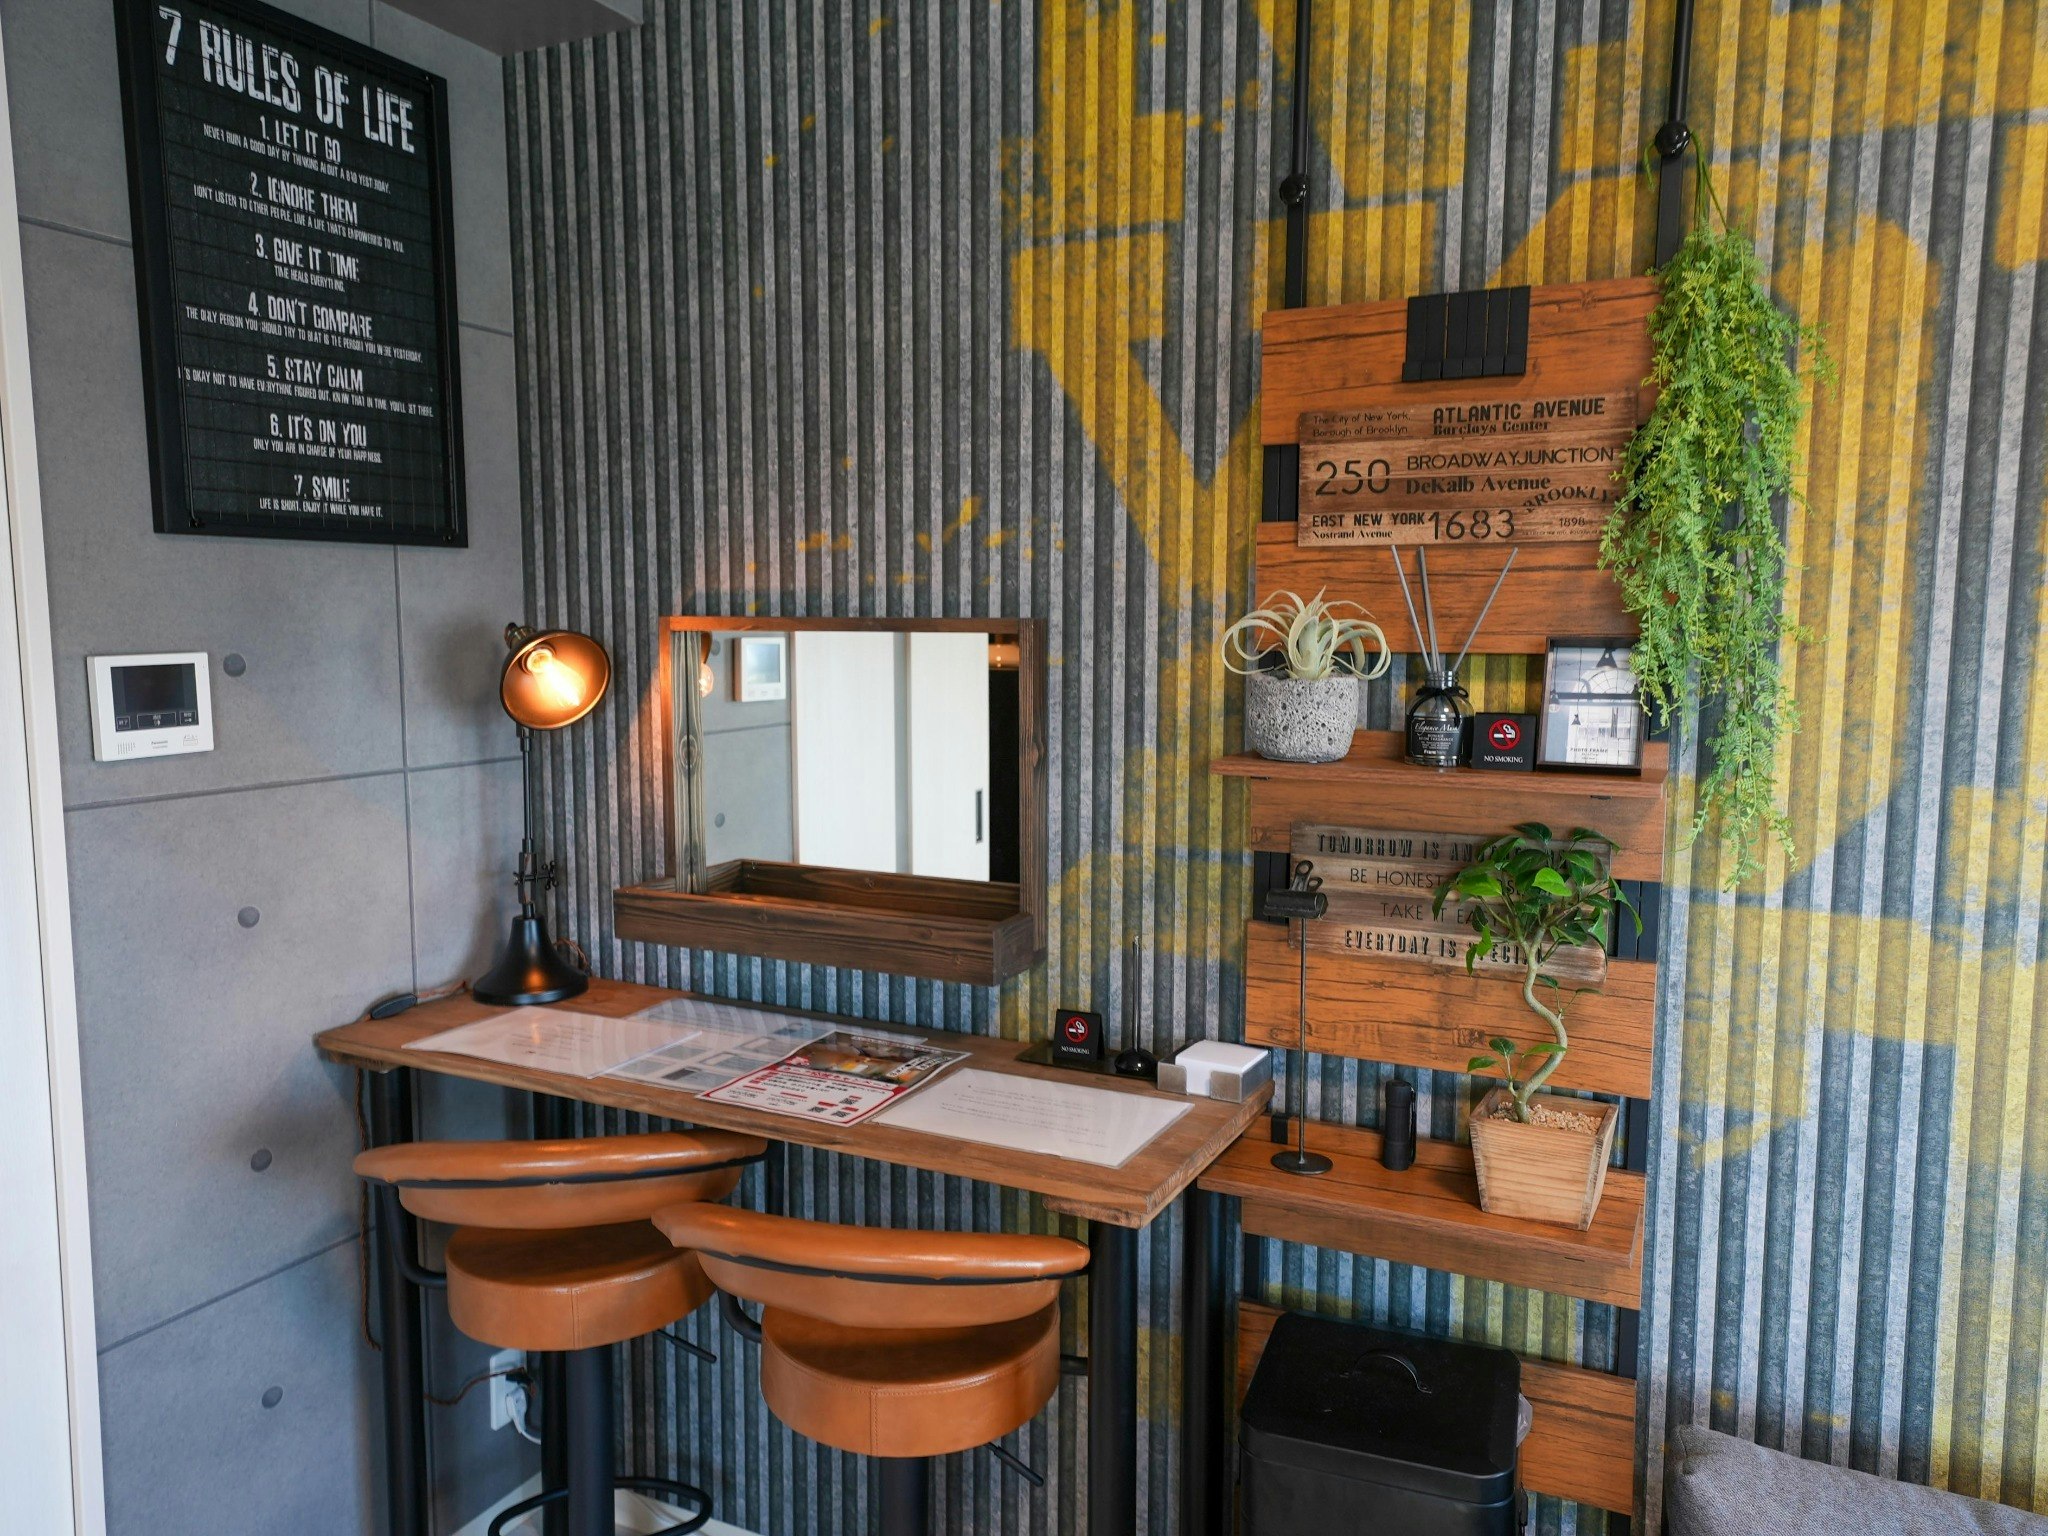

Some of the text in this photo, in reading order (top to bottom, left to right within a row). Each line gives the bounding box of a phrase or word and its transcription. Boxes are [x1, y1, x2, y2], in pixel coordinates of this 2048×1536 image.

[159, 5, 415, 154] 7 RULES OF LIFE
[203, 123, 225, 142] NEVER
[226, 130, 242, 147] RUIN
[243, 136, 249, 149] A
[249, 138, 266, 155] GOOD
[267, 144, 280, 159] DAY
[281, 150, 290, 163] BY
[340, 168, 345, 180] A
[260, 115, 341, 164] 1. LET IT GO
[249, 171, 358, 226] 2. IGNORE THEM
[214, 189, 237, 208] LISTEN
[239, 196, 248, 210] TO
[293, 212, 306, 226] LIVE
[307, 216, 313, 228] A
[314, 218, 326, 232] LIFE
[326, 221, 347, 238] THAT'S
[384, 237, 391, 250] TO
[255, 233, 360, 283] 3. GIVE IT TIME
[274, 264, 289, 280] TIME
[290, 268, 309, 284] HEALS
[185, 306, 199, 320] THE
[200, 308, 217, 324] ONLY
[219, 312, 244, 329] PERSON
[245, 317, 258, 331] YOU
[284, 325, 296, 339] TRY
[297, 328, 306, 341] TO
[323, 332, 330, 346] IS
[365, 341, 376, 354] YOU
[248, 291, 373, 340] 4. DON'T COMPARE
[177, 366, 191, 380] I'S
[192, 369, 211, 384] OKAY
[213, 372, 226, 386] NOT
[228, 374, 237, 388] TO
[239, 376, 255, 391] HAVE
[256, 379, 292, 396] EVRYTHING
[294, 385, 317, 400] FIGURED
[318, 389, 331, 402] OUT.
[366, 396, 373, 409] IN
[267, 354, 364, 393] 5. STAY CALM
[1313, 411, 1411, 425] The City of New York,
[1433, 397, 1606, 424] ATLANTIC AVENUE
[270, 413, 367, 448] 6. IT'S ON YOU
[1313, 423, 1408, 438] Borough of Brooklyn
[1433, 420, 1551, 437] Barclays Center
[253, 438, 269, 451] ONLY
[271, 441, 284, 453] YOU
[298, 443, 305, 455] IN
[328, 446, 336, 459] OF
[353, 449, 382, 463] HAPPNESS.
[294, 474, 351, 503] 7. SMILE
[1315, 459, 1391, 496] 250
[1406, 476, 1551, 495] DeKalb Avenue
[259, 498, 271, 510] LIFE
[273, 499, 280, 510] IS
[280, 499, 301, 512] SHORT.
[302, 500, 320, 513] ENJOY
[323, 502, 329, 514] IT
[329, 502, 347, 515] WHILE
[348, 503, 359, 516] YOU
[375, 506, 383, 518] IT.
[1312, 512, 1425, 528] EAST NEW YORK
[1559, 517, 1586, 528] 1898
[1313, 529, 1393, 540] Nostrand Avenue
[1428, 509, 1515, 540] 1683
[1317, 834, 1413, 858] TOMORROW
[1423, 840, 1440, 859] IS
[1350, 868, 1444, 889] BE HONEST
[1381, 902, 1423, 920] TAKE
[1457, 908, 1500, 927] EAY
[1344, 929, 1429, 955] EVERYDAY
[1439, 938, 1457, 958] IS
